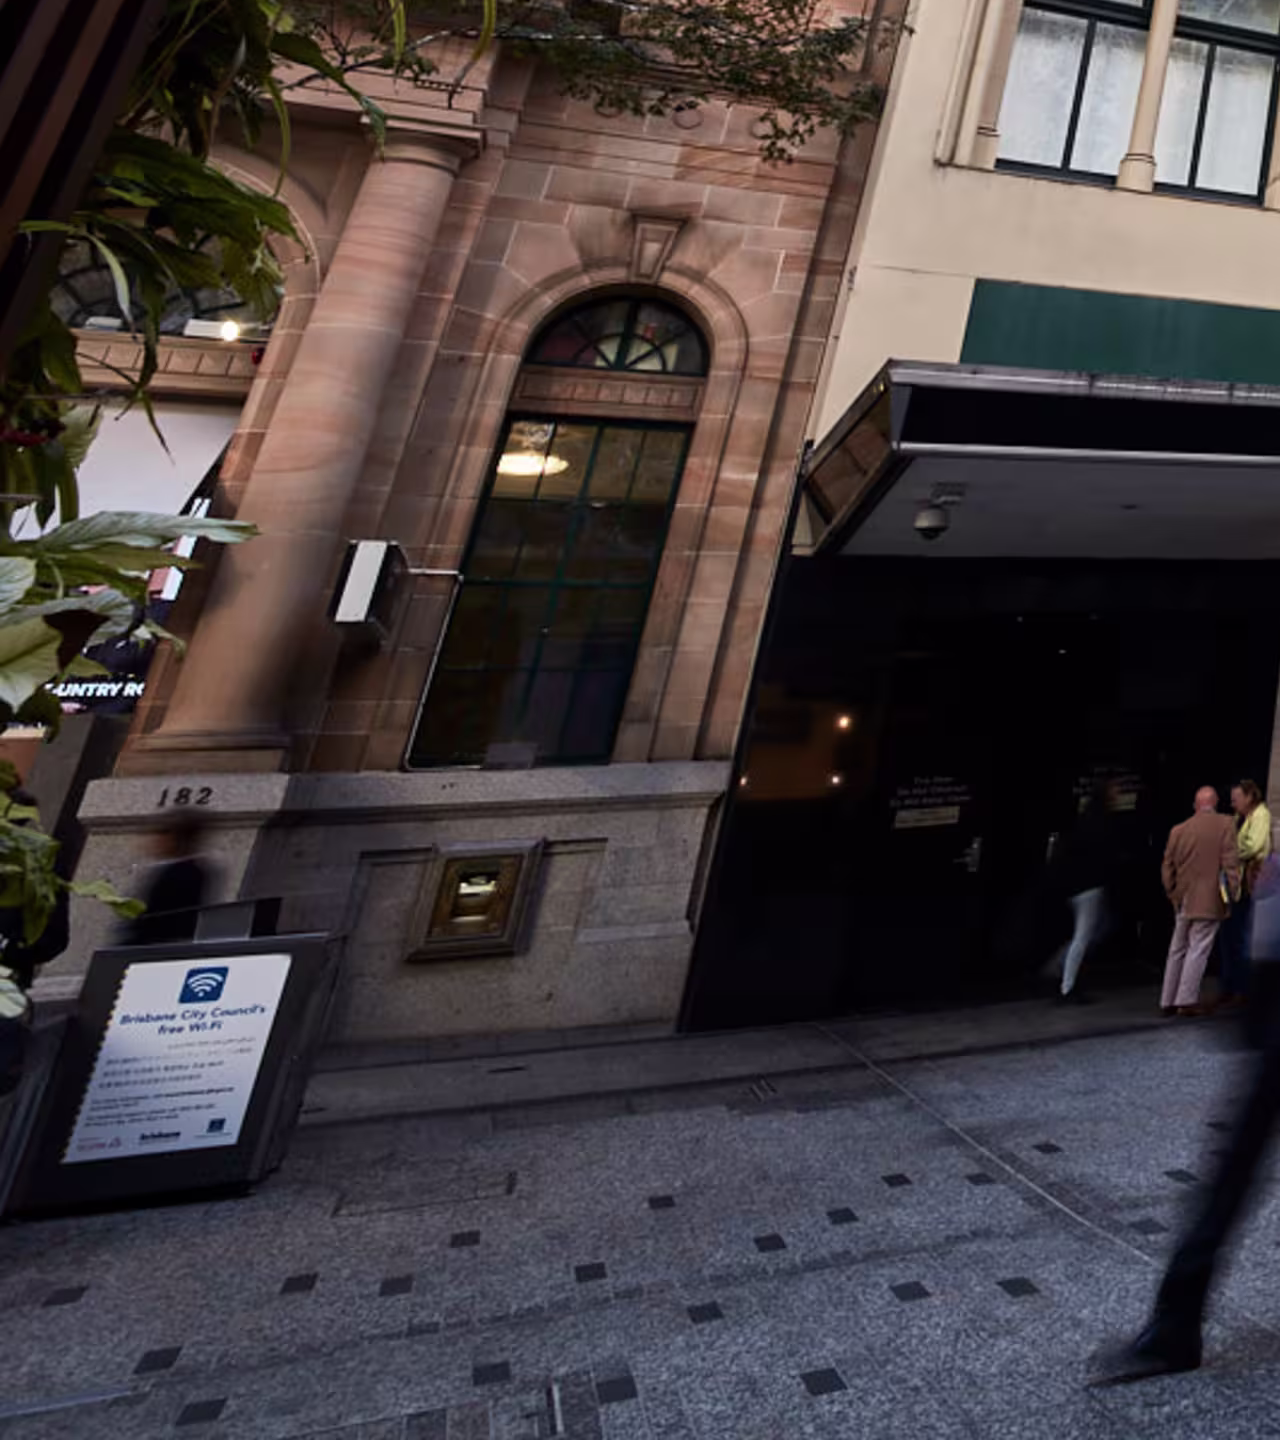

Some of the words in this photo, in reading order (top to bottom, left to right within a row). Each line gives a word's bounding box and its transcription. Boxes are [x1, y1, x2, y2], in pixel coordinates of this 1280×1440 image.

[157, 786, 213, 808] 182
[120, 1011, 177, 1026] Brisbane
[180, 1007, 208, 1022] City
[210, 1003, 267, 1019] Council's
[158, 1023, 185, 1036] free
